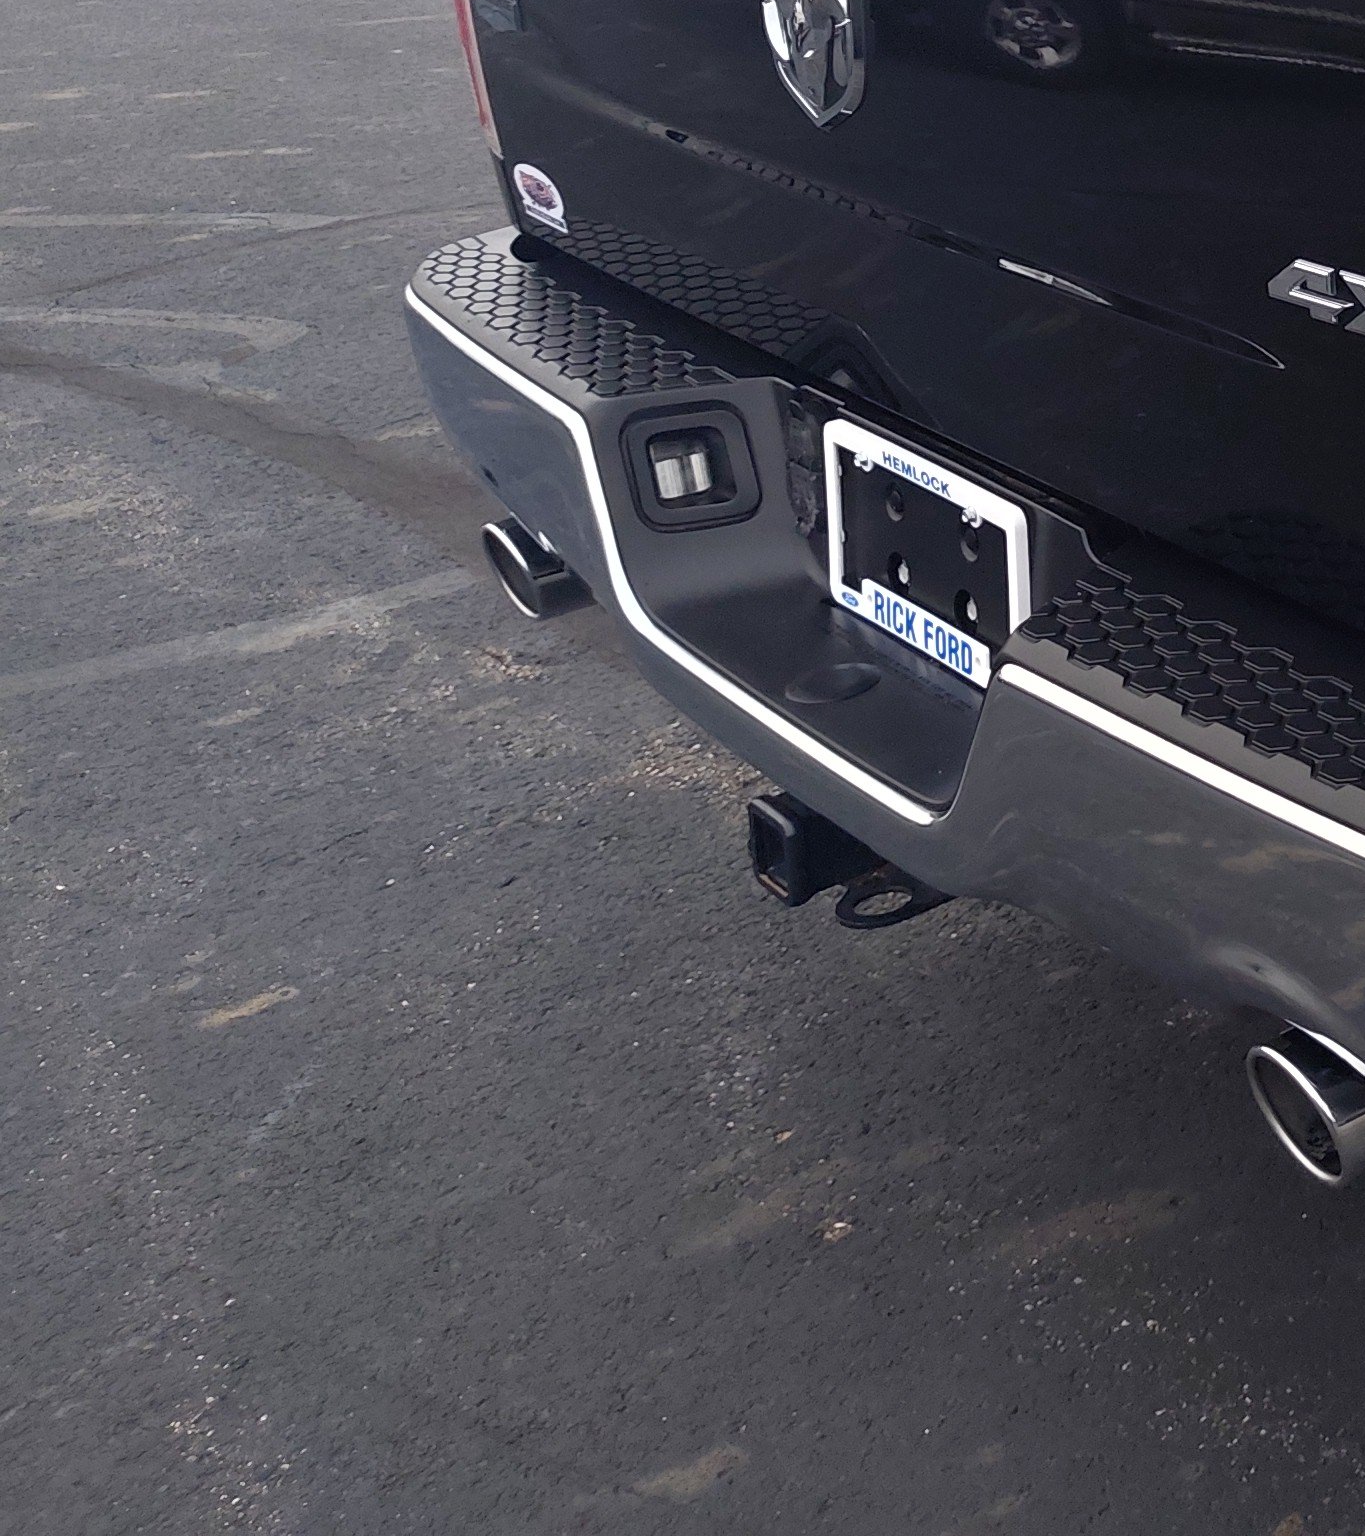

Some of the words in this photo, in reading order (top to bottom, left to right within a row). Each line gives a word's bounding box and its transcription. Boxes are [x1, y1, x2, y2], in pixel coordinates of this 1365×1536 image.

[882, 451, 951, 499] HEMLOCK
[874, 589, 918, 644] RICK
[923, 617, 973, 676] FORD
